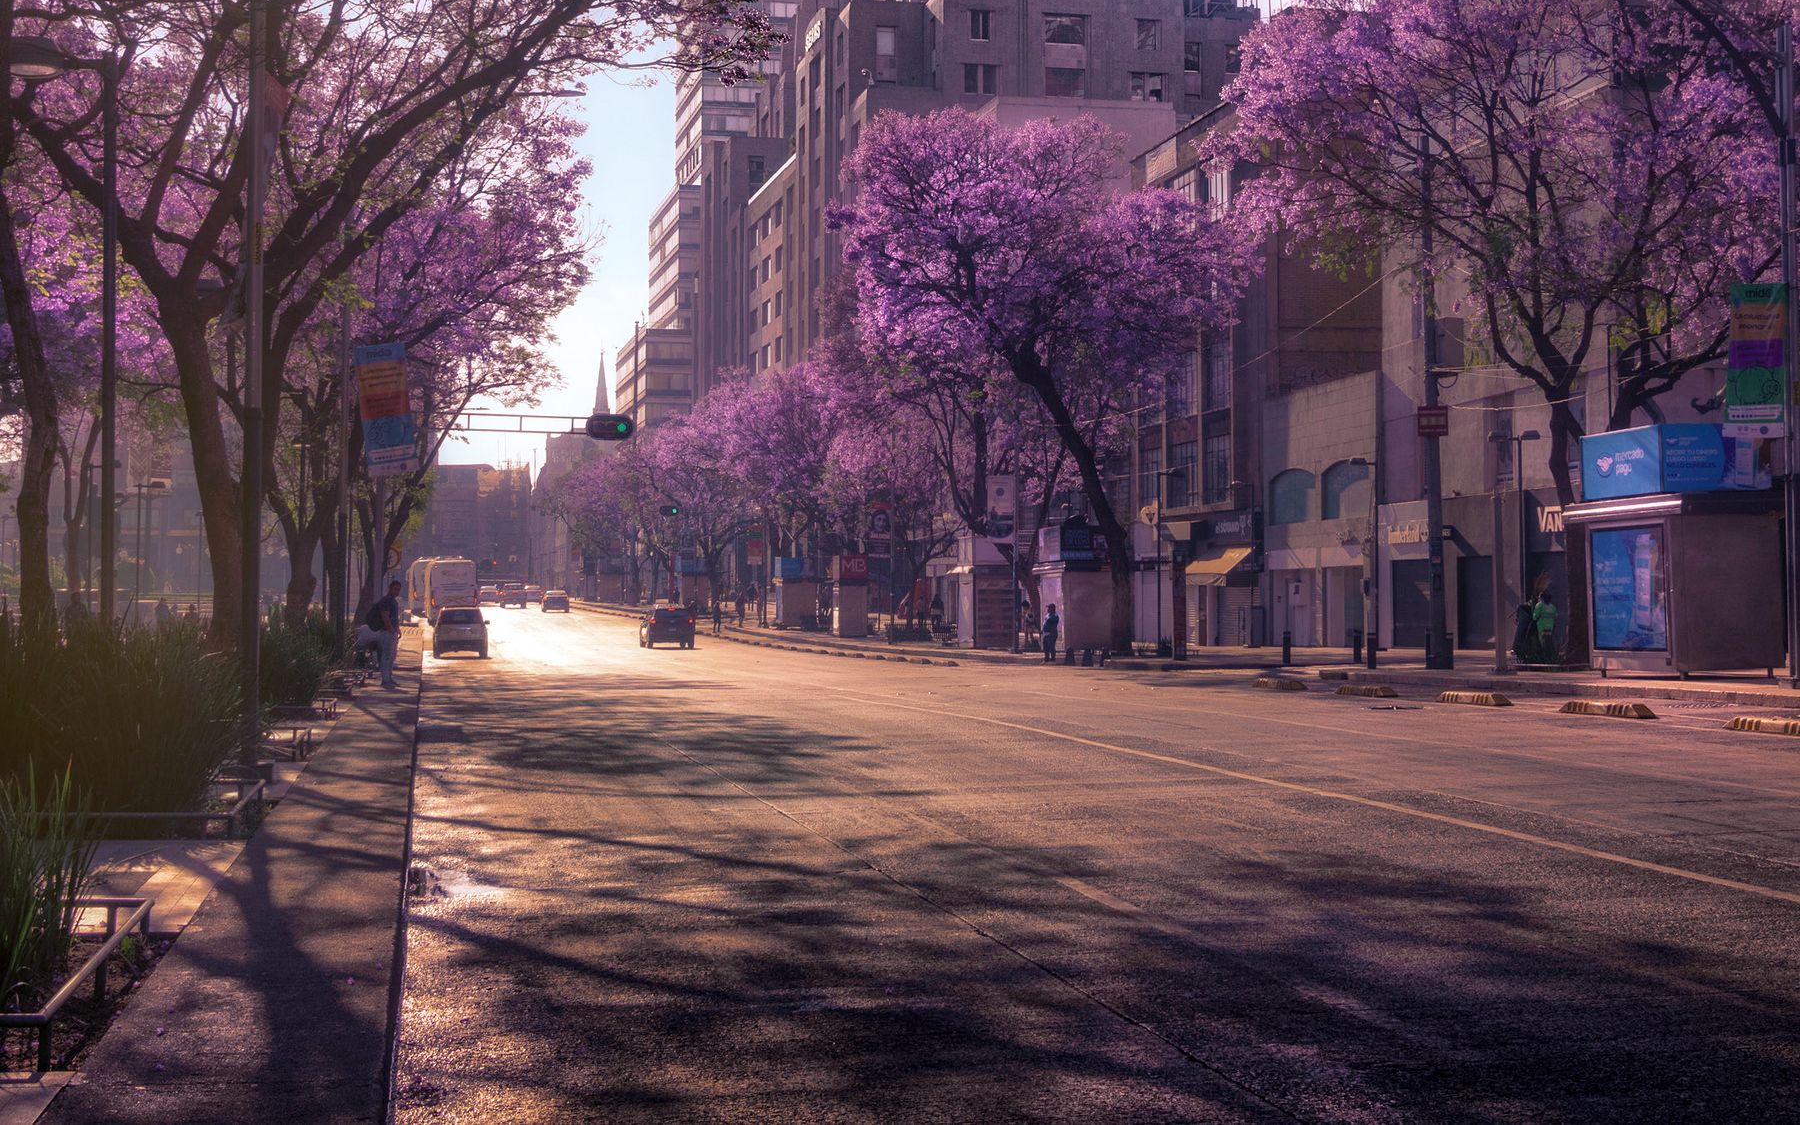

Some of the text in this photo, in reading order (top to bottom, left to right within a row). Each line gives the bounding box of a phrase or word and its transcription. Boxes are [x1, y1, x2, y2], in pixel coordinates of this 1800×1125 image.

[1614, 447, 1645, 462] mercado
[1615, 463, 1633, 477] pago
[1537, 505, 1565, 533] VAN
[1387, 523, 1420, 545] Timberland
